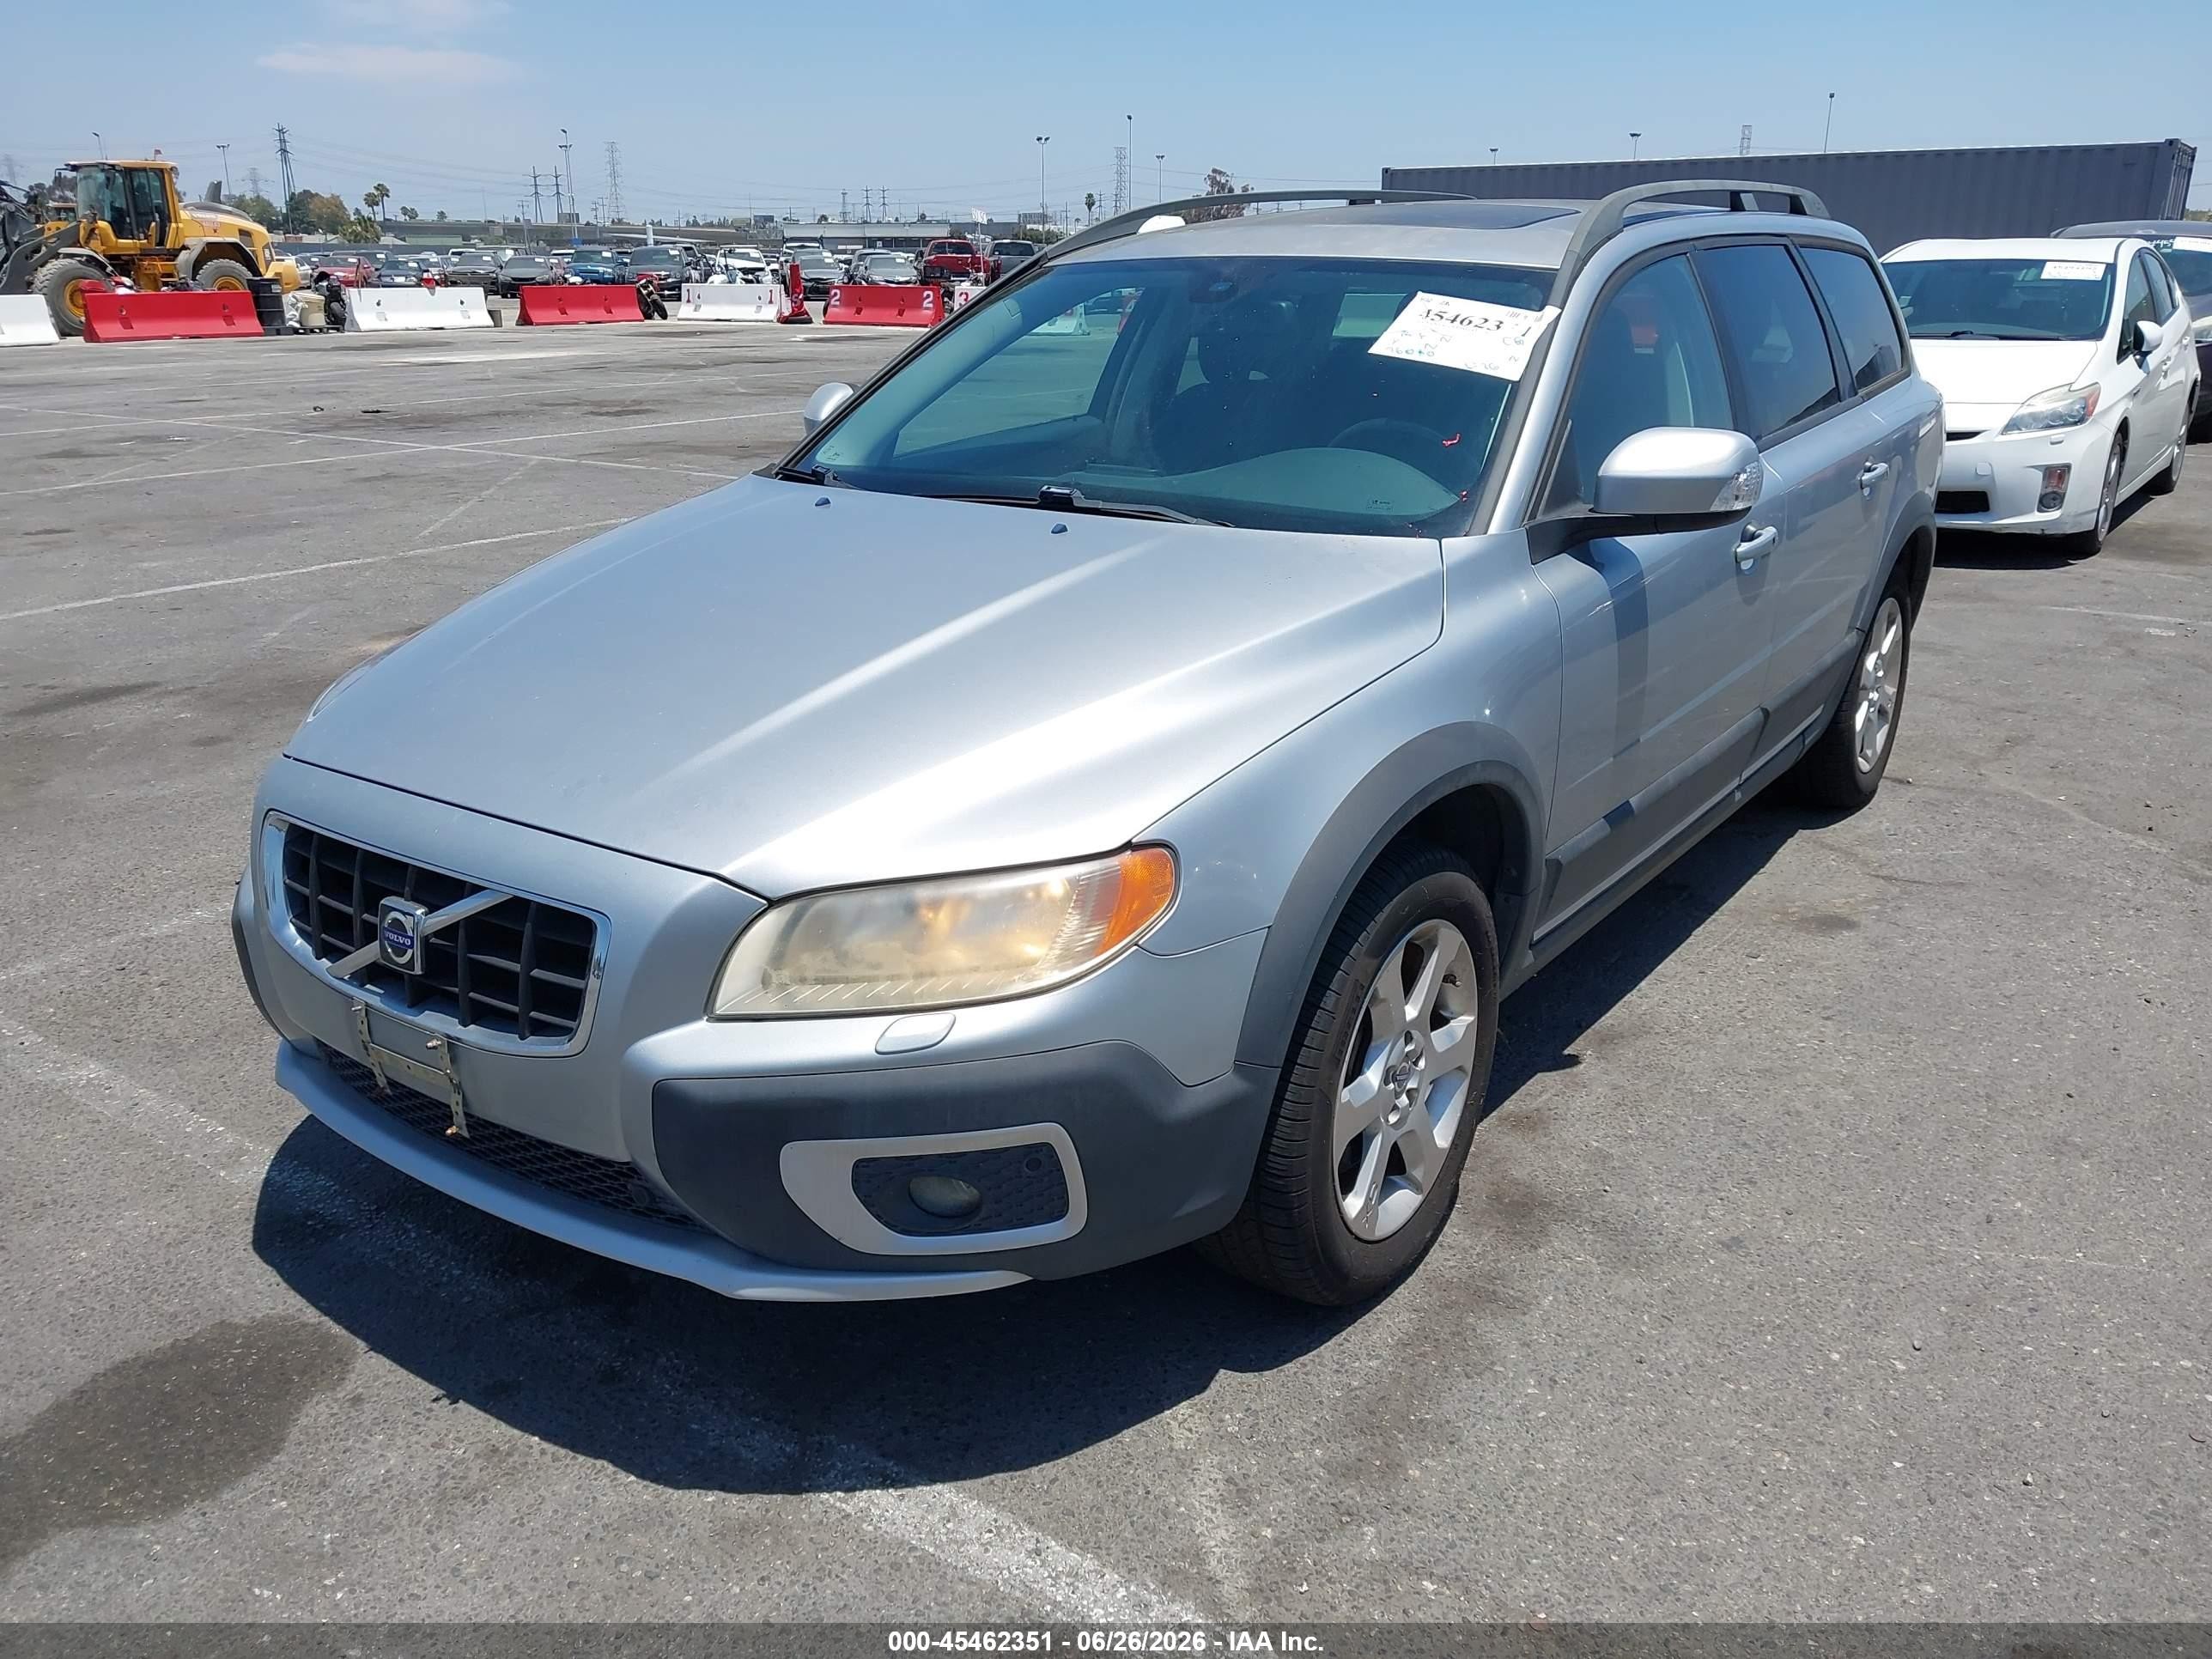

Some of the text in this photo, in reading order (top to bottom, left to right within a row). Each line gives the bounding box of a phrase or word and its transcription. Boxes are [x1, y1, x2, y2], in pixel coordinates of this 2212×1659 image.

[686, 289, 692, 303] 1
[769, 289, 775, 304] 1
[830, 289, 842, 305] 2
[923, 291, 933, 307] 2
[958, 292, 969, 308] 3
[385, 932, 411, 945] VOLVO
